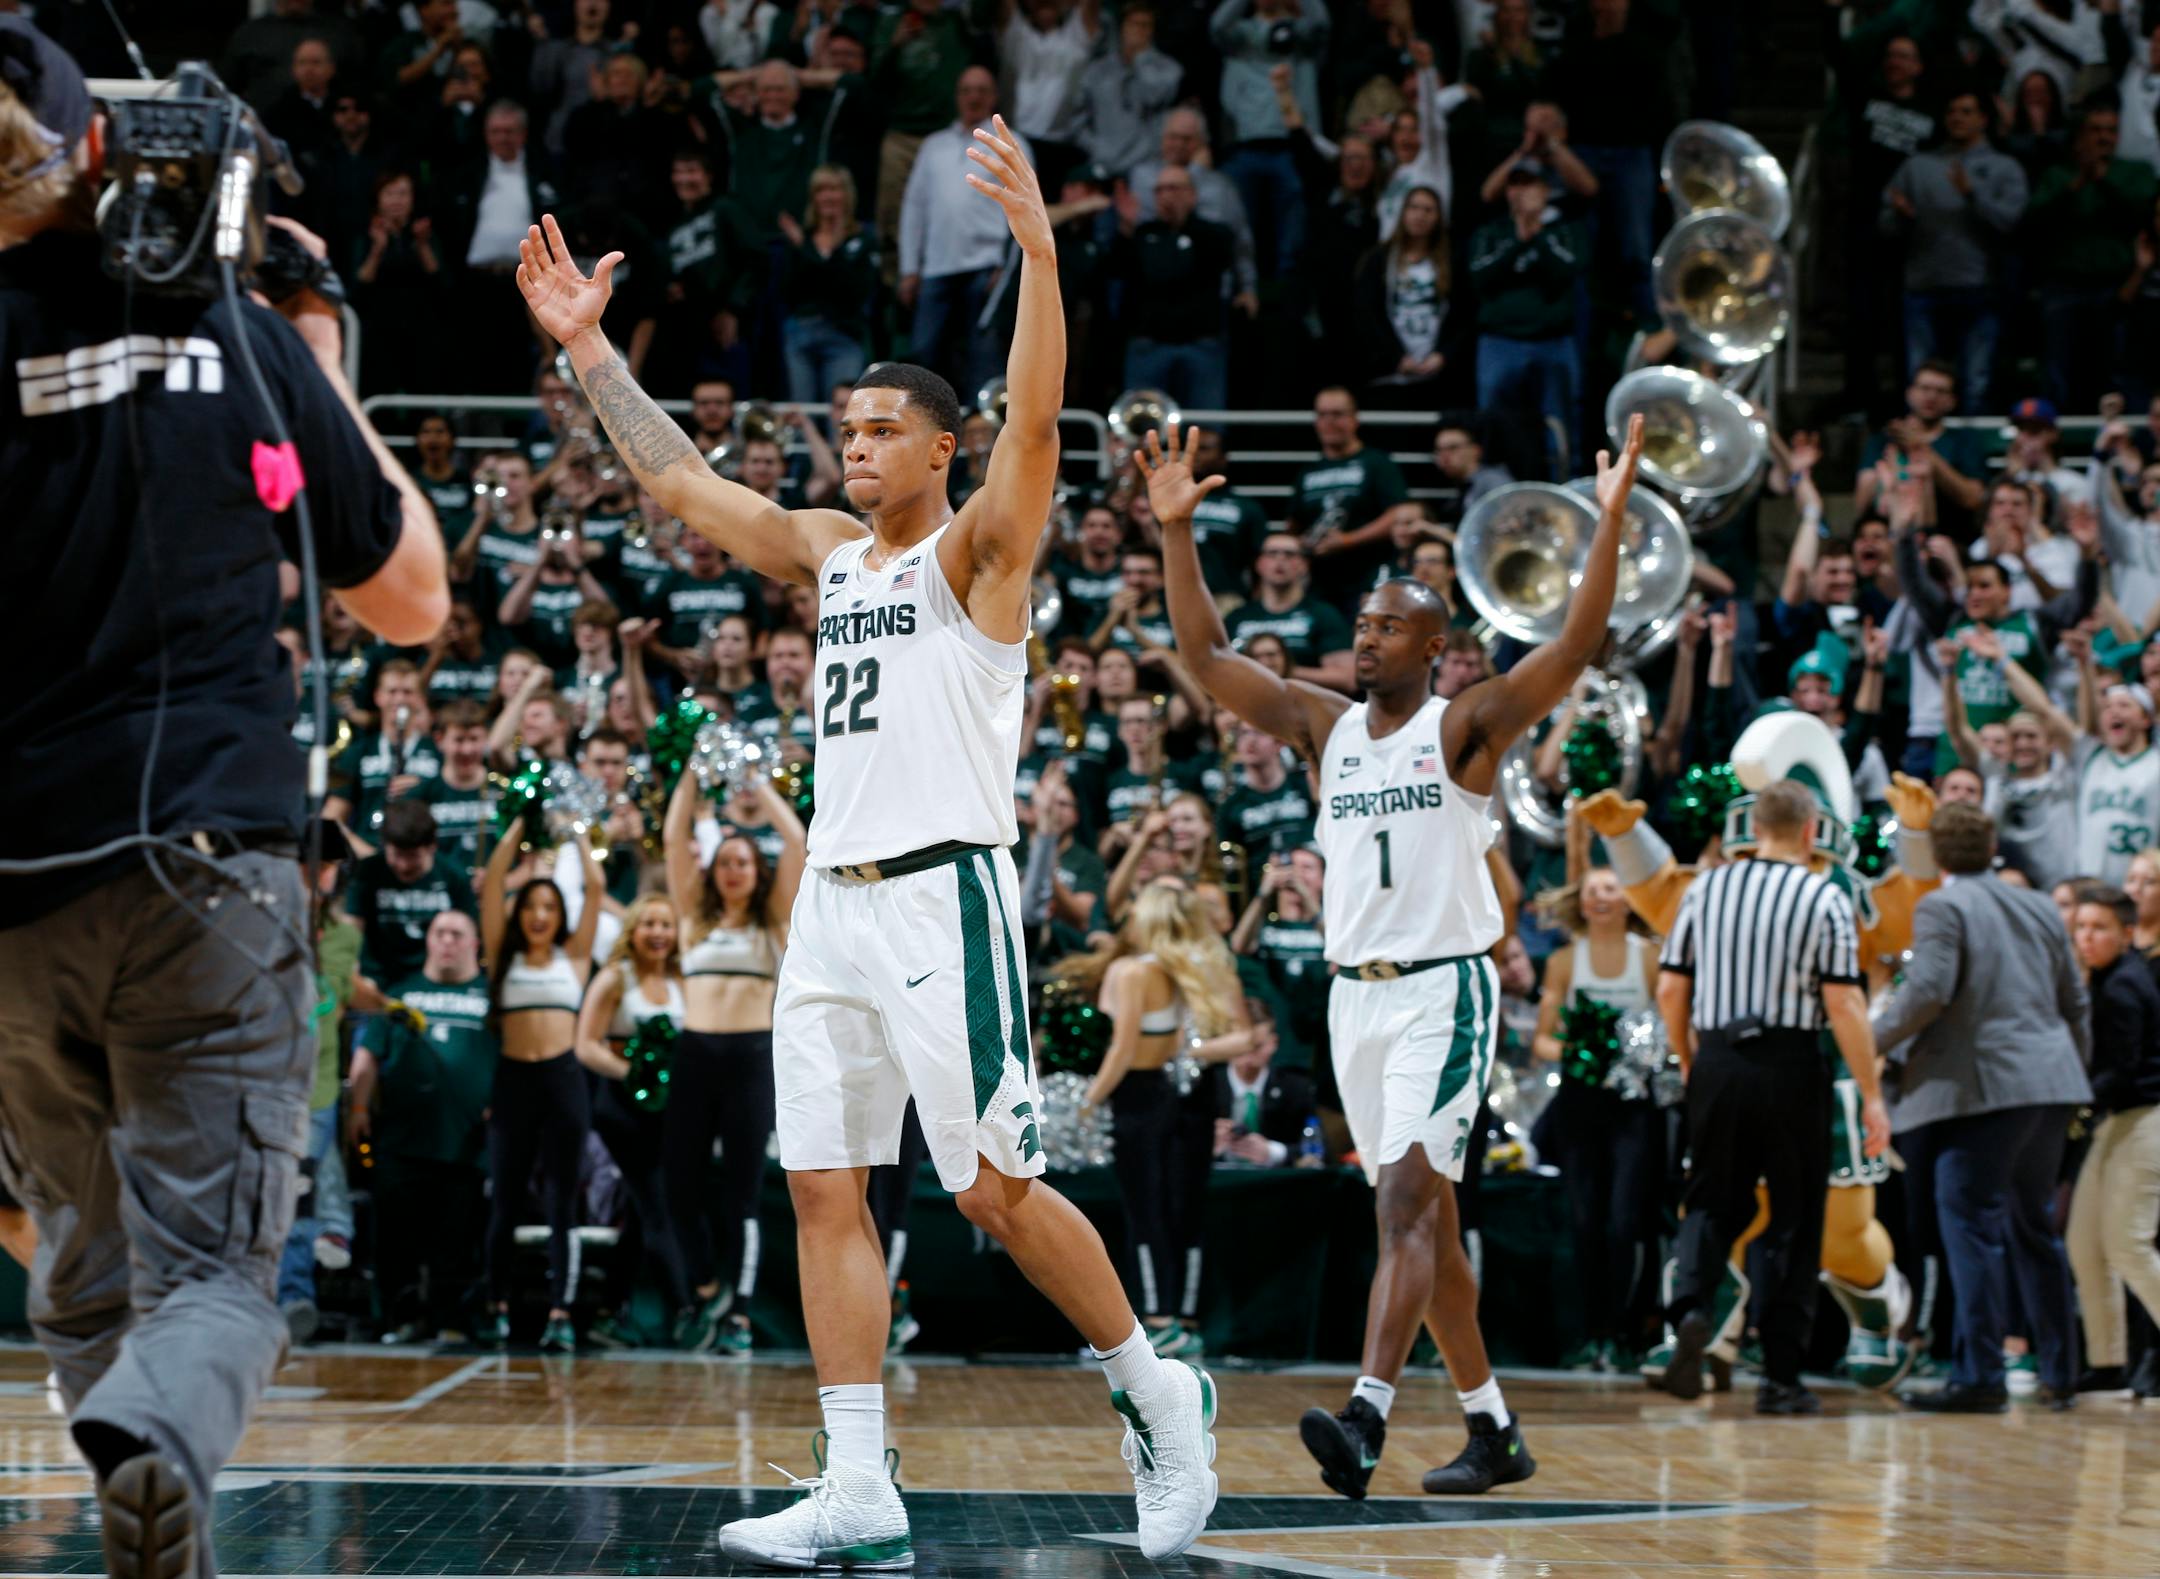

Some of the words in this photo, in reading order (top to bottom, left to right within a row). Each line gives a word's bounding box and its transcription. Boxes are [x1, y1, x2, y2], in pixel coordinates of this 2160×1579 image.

[16, 334, 223, 417] ESPN
[819, 603, 916, 650] PARTANS
[823, 656, 880, 739] 22
[1331, 783, 1442, 819] SPARTANS
[1374, 830, 1392, 889] 1
